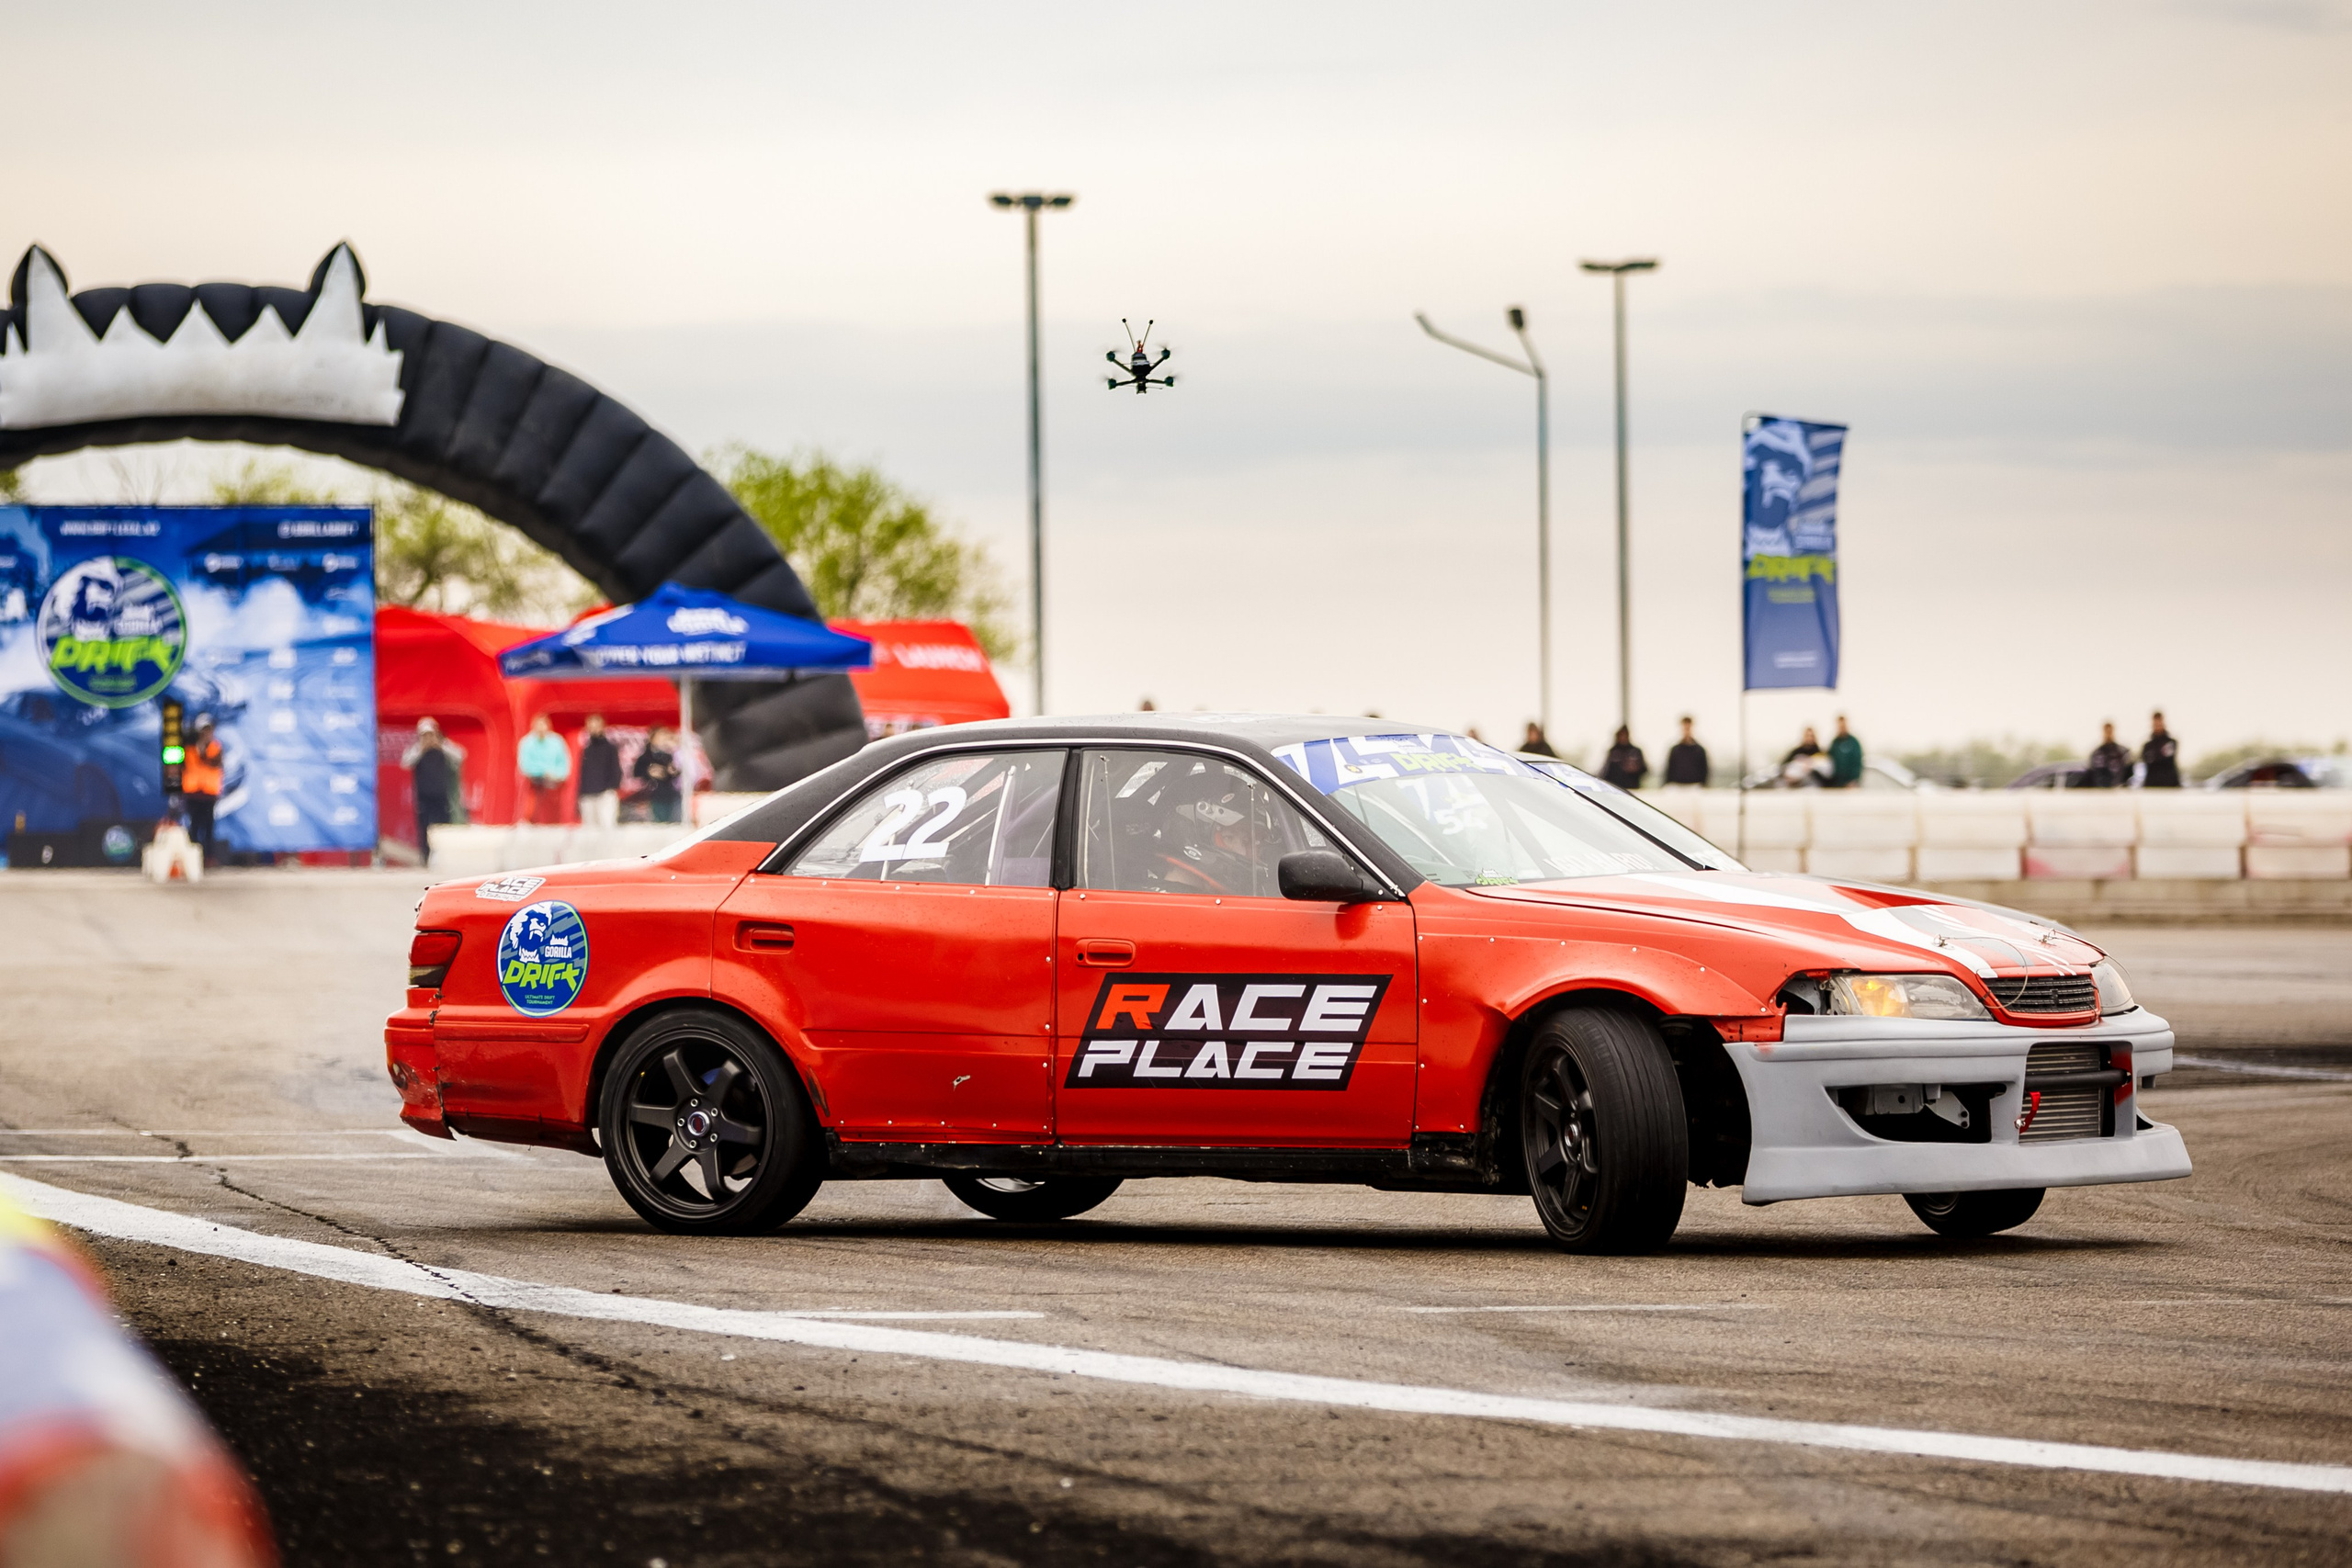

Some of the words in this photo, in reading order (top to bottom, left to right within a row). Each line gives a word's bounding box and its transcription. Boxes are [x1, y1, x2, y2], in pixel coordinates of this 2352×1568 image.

[859, 786, 967, 862] 22
[479, 883, 532, 896] PLACE
[544, 945, 572, 958] GORILLA
[503, 959, 580, 992] DRIFT
[1095, 984, 1377, 1032] RACE
[1078, 1040, 1353, 1079] PLACE
